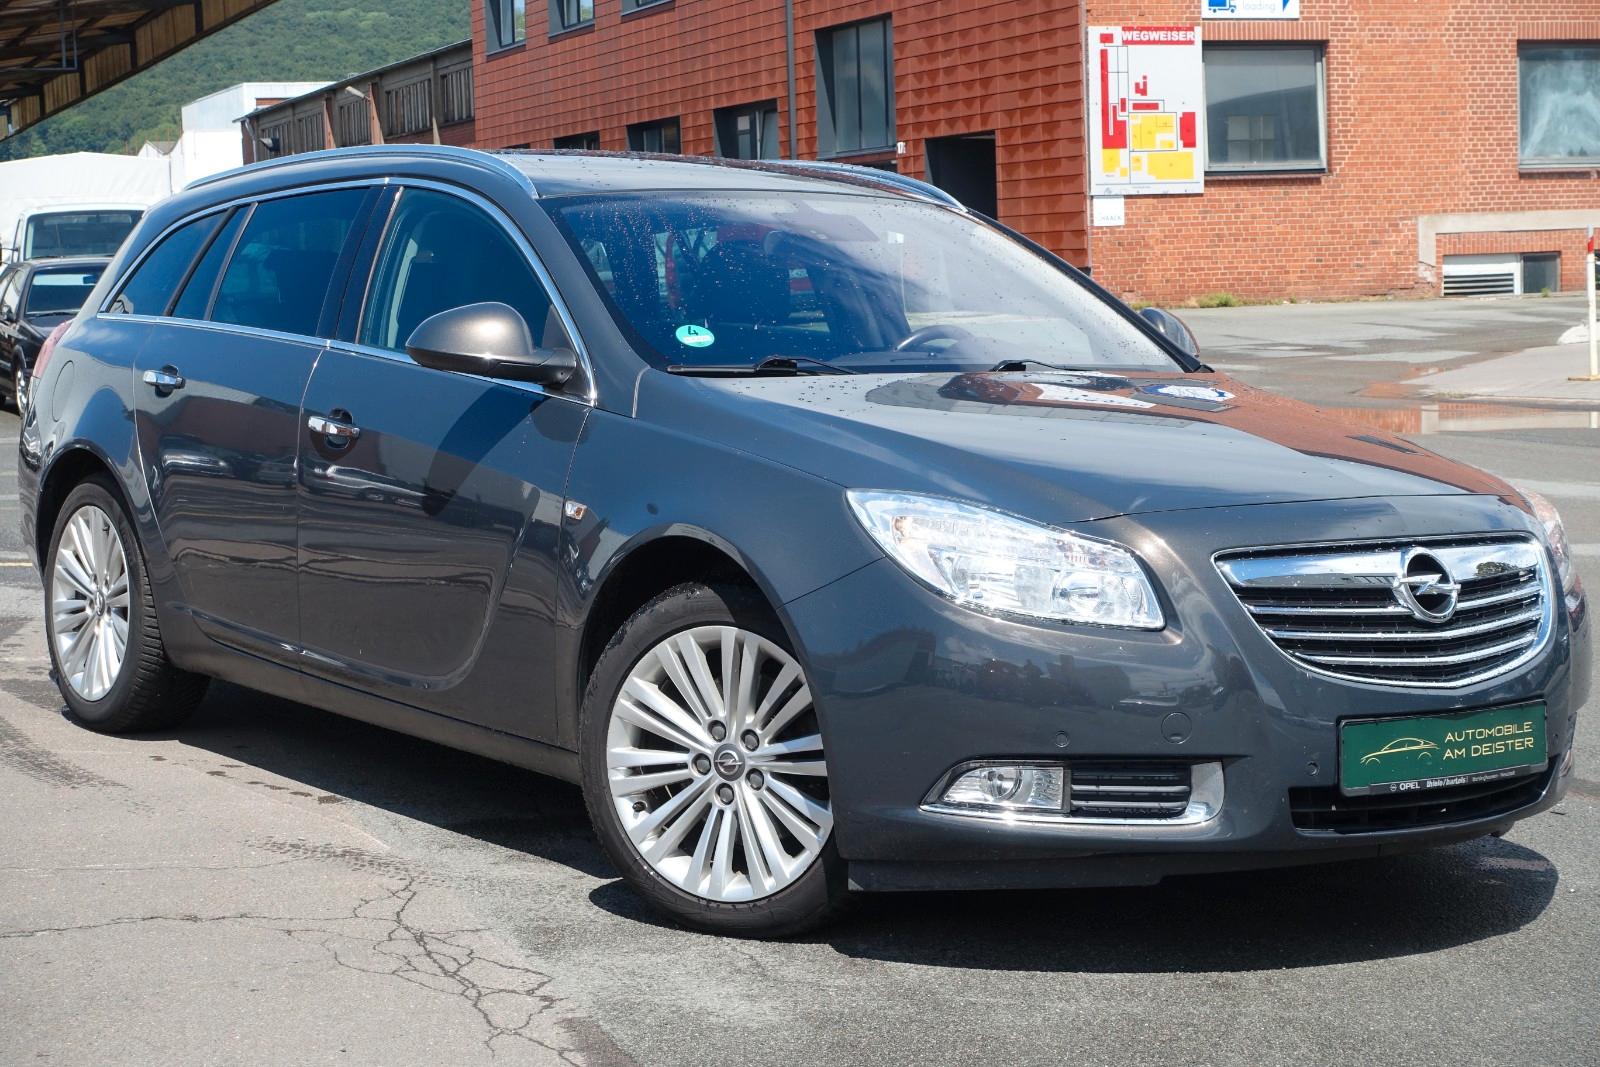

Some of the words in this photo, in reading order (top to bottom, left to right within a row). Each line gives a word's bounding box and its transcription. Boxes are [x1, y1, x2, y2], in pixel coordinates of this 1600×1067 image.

[1243, 0, 1276, 14] loading
[1122, 30, 1195, 41] WEGWEISER
[687, 325, 699, 336] 4
[1444, 721, 1533, 743] AUTOMOBILE
[1443, 748, 1466, 760] AM
[1471, 737, 1534, 757] DEISTER
[1399, 782, 1420, 791] OPEL
